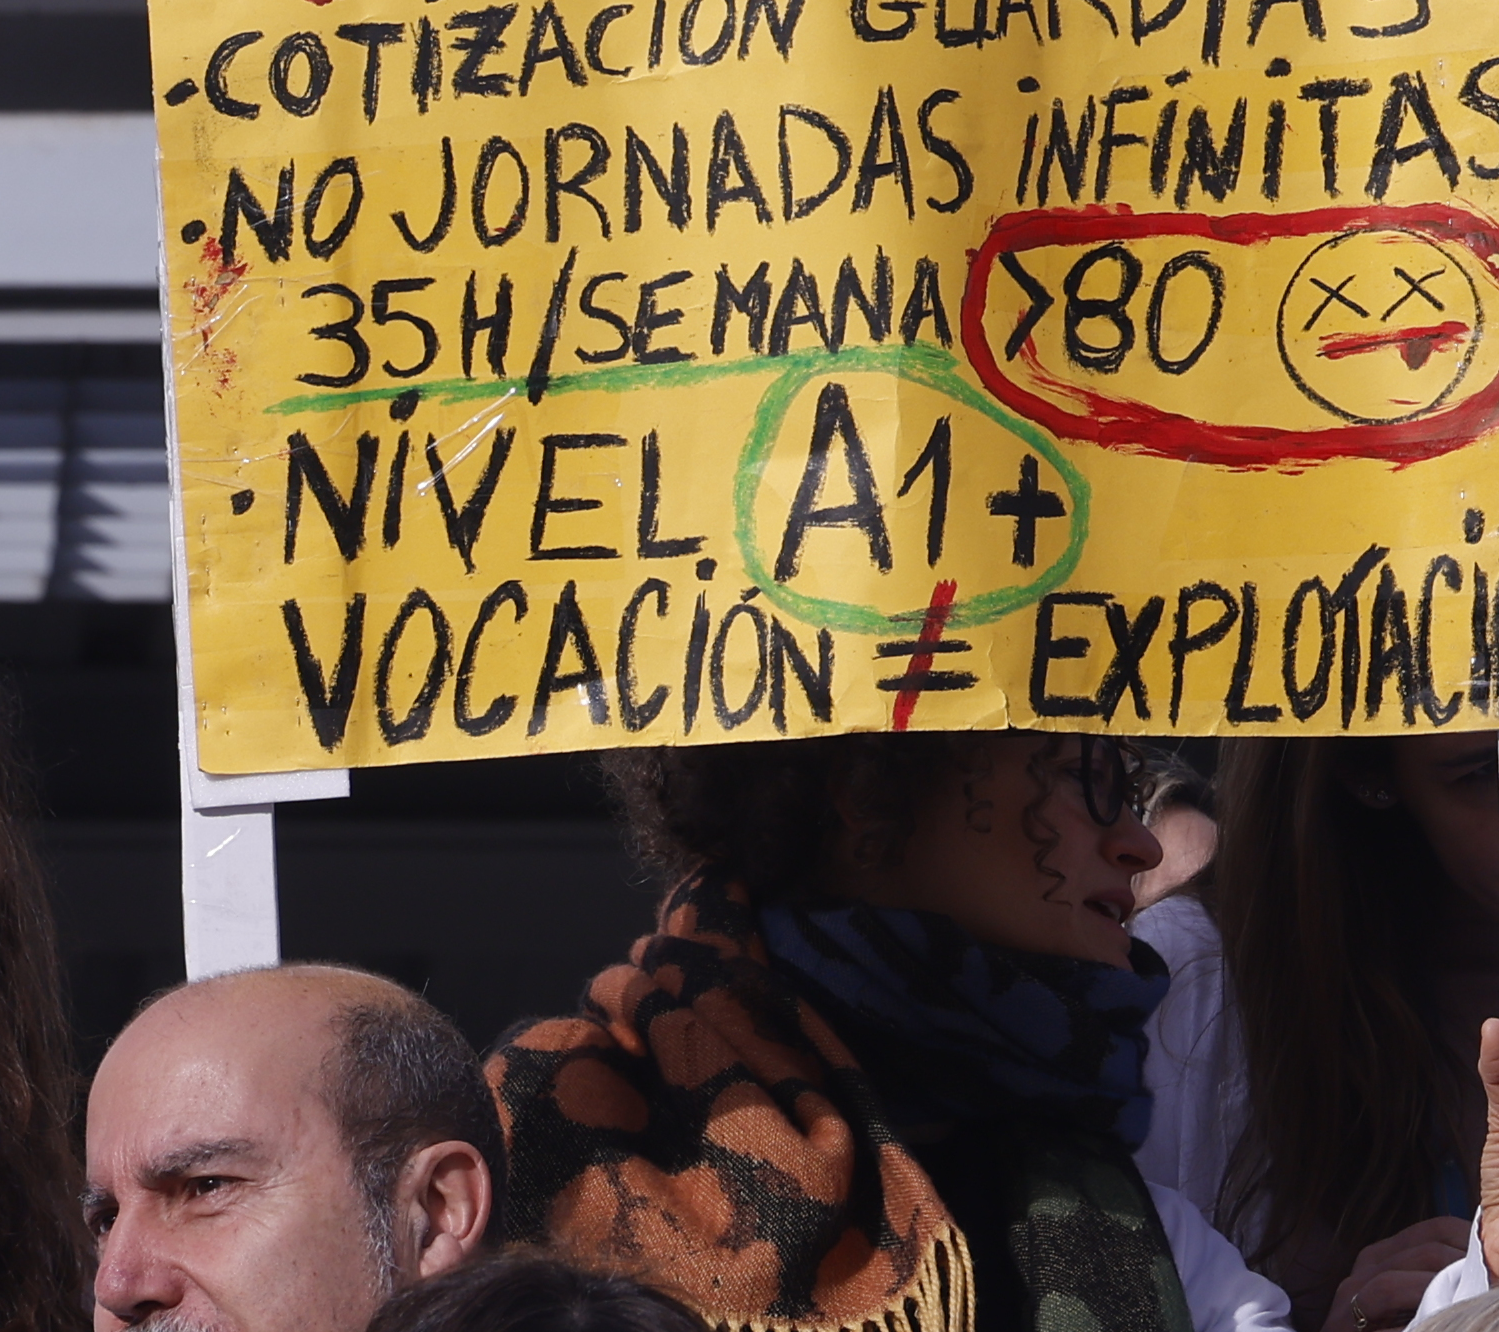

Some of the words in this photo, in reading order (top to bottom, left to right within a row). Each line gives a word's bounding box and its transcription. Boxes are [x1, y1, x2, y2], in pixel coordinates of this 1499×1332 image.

[391, 83, 976, 257] JORNADAS
[298, 244, 955, 405] 35H/SEMANA
[278, 554, 837, 751] VOCACIÓN
